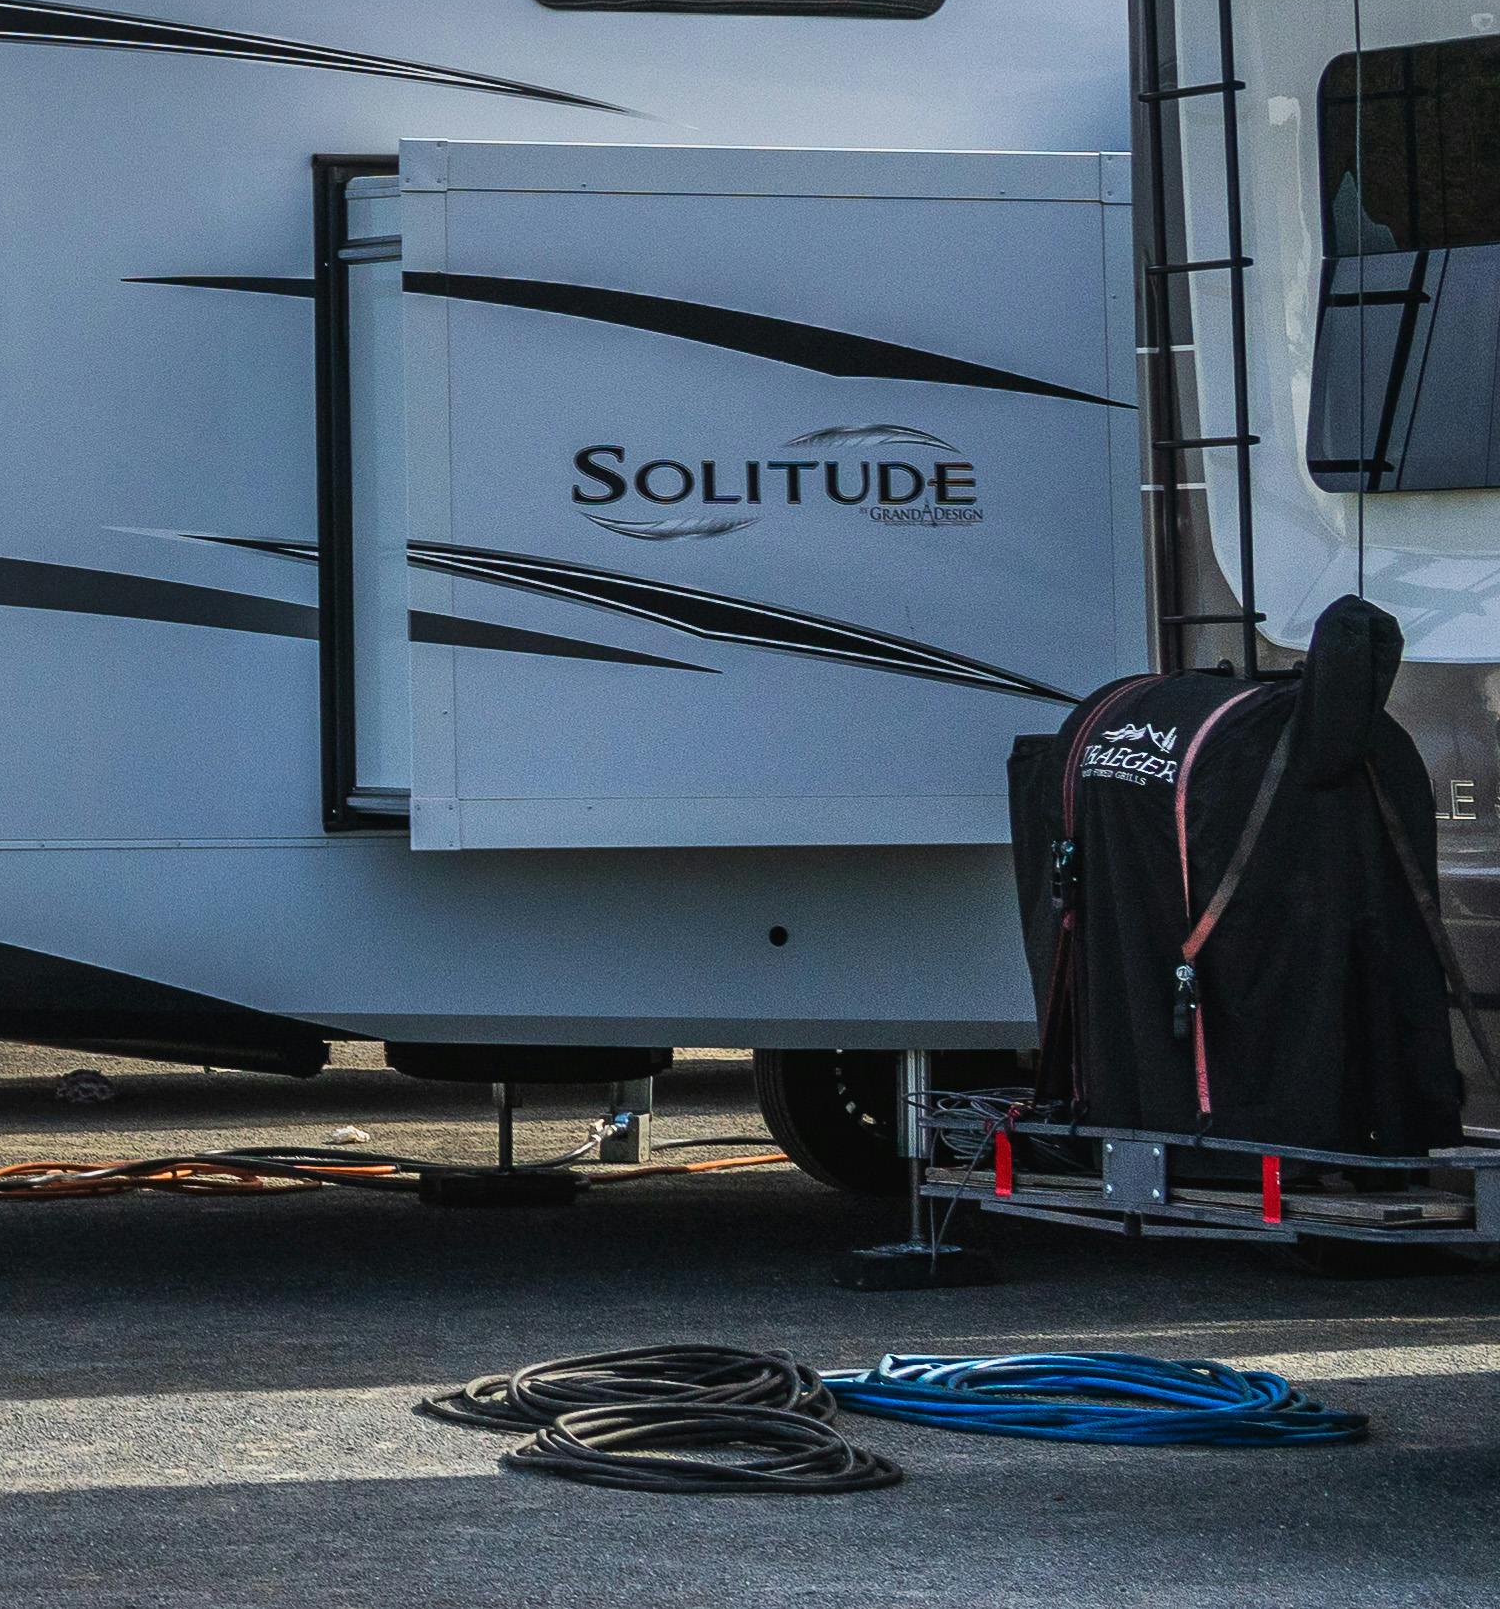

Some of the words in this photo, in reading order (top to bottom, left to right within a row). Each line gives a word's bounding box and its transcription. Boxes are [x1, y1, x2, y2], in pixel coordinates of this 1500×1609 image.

[571, 444, 978, 506] SOLITUDE
[869, 506, 921, 521] GRAND
[933, 506, 984, 521] DESIGN
[1114, 770, 1148, 787] GRILLS
